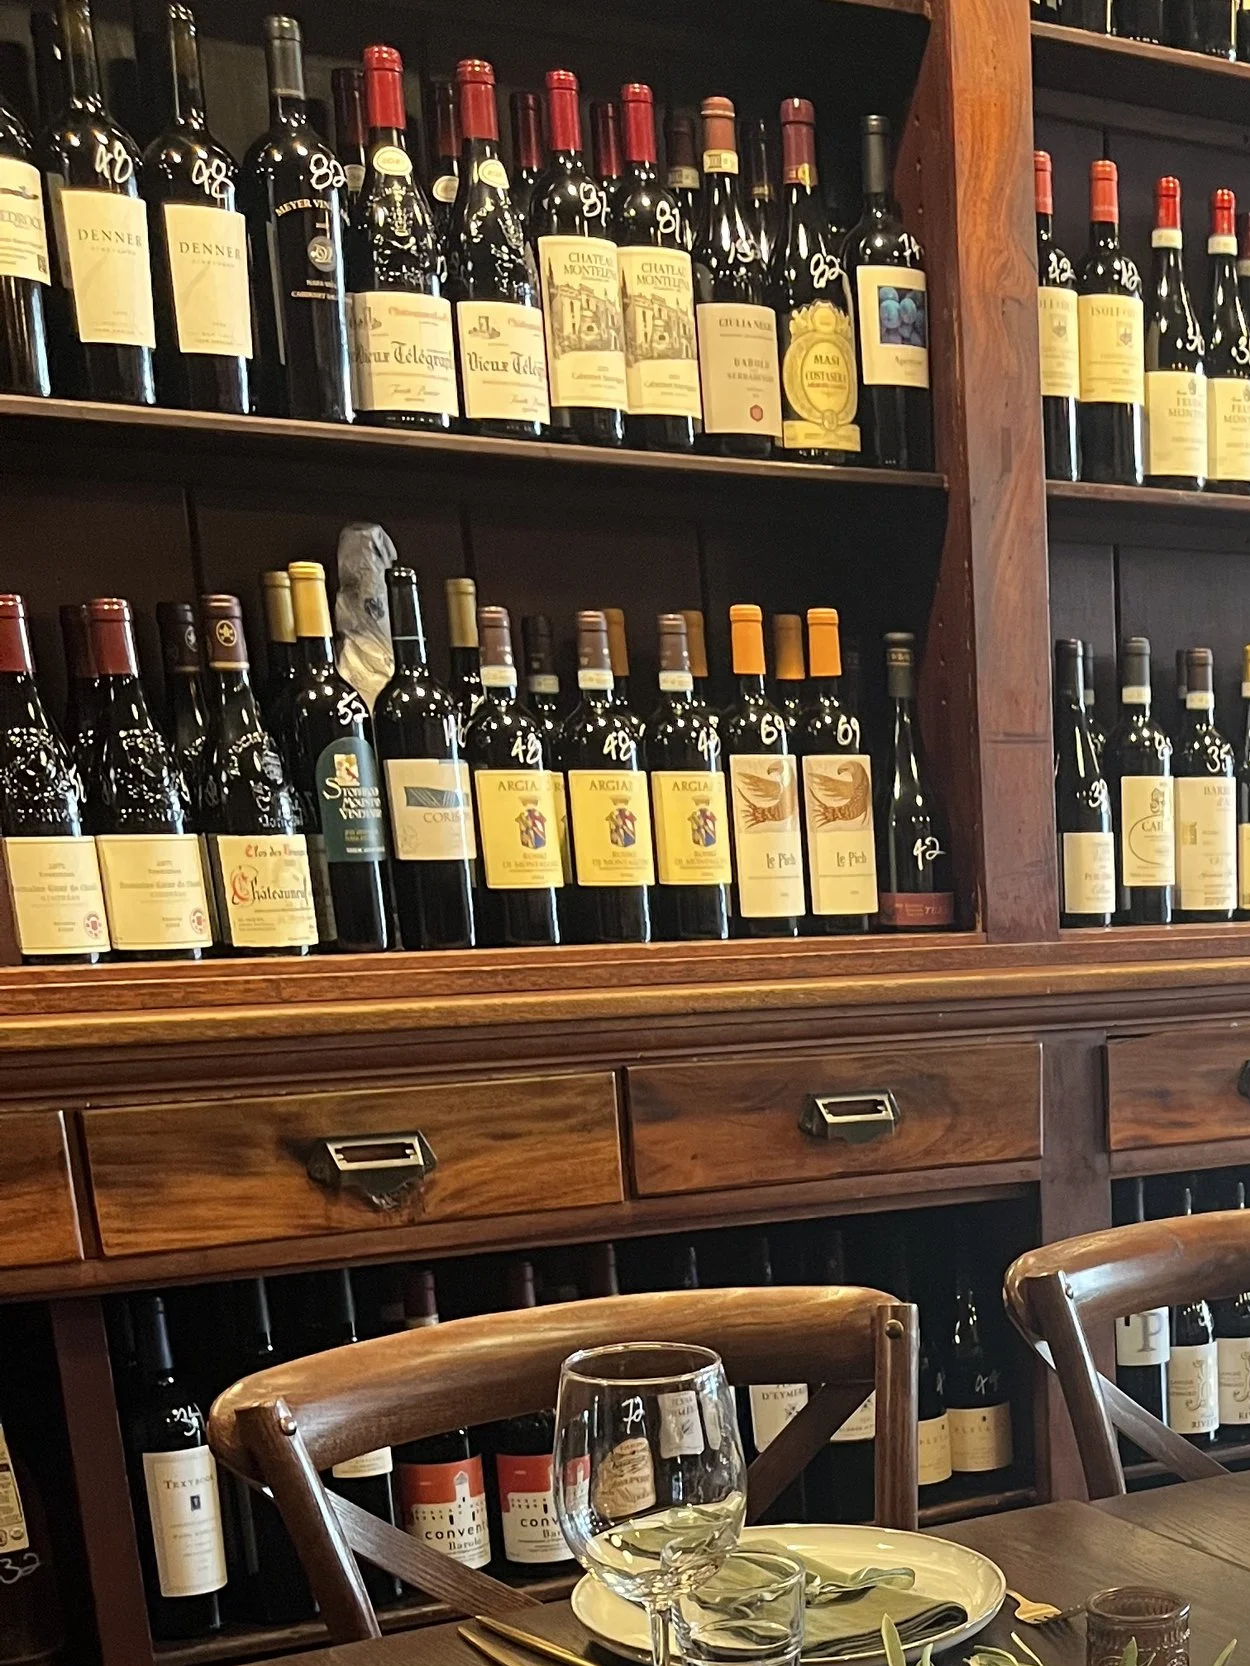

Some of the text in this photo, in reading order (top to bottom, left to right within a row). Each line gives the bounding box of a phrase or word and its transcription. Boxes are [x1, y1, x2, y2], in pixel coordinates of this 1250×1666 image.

[309, 153, 348, 190] 82
[275, 198, 313, 217] MEYER
[77, 228, 144, 249] DENNER
[179, 240, 243, 262] DENNER
[467, 351, 509, 373] Vieux
[813, 354, 841, 367] MASI
[336, 690, 370, 726] 52
[760, 712, 786, 746] 69
[837, 714, 860, 750] 69
[603, 730, 638, 763] 48
[766, 854, 776, 869] Le
[836, 851, 868, 868] Le Pich
[912, 836, 946, 871] 42
[621, 1394, 646, 1435] 72
